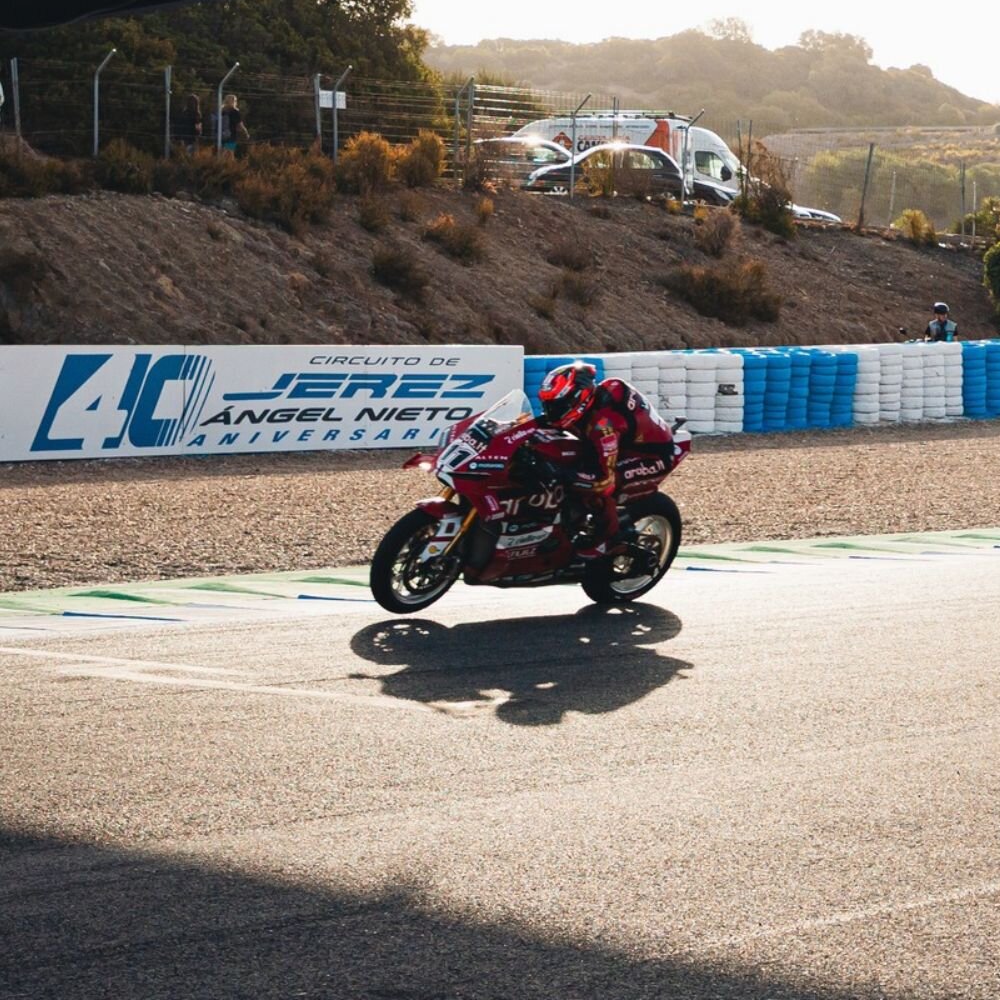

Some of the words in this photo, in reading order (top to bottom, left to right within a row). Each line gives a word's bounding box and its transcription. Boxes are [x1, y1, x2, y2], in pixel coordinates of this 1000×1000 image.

[309, 355, 421, 366] CIRCUITO
[429, 357, 461, 366] DE
[222, 373, 496, 400] JEREZ
[200, 405, 343, 426] ÁNGEL
[354, 406, 473, 422] NIETO
[186, 427, 440, 447] ANIVERSARI
